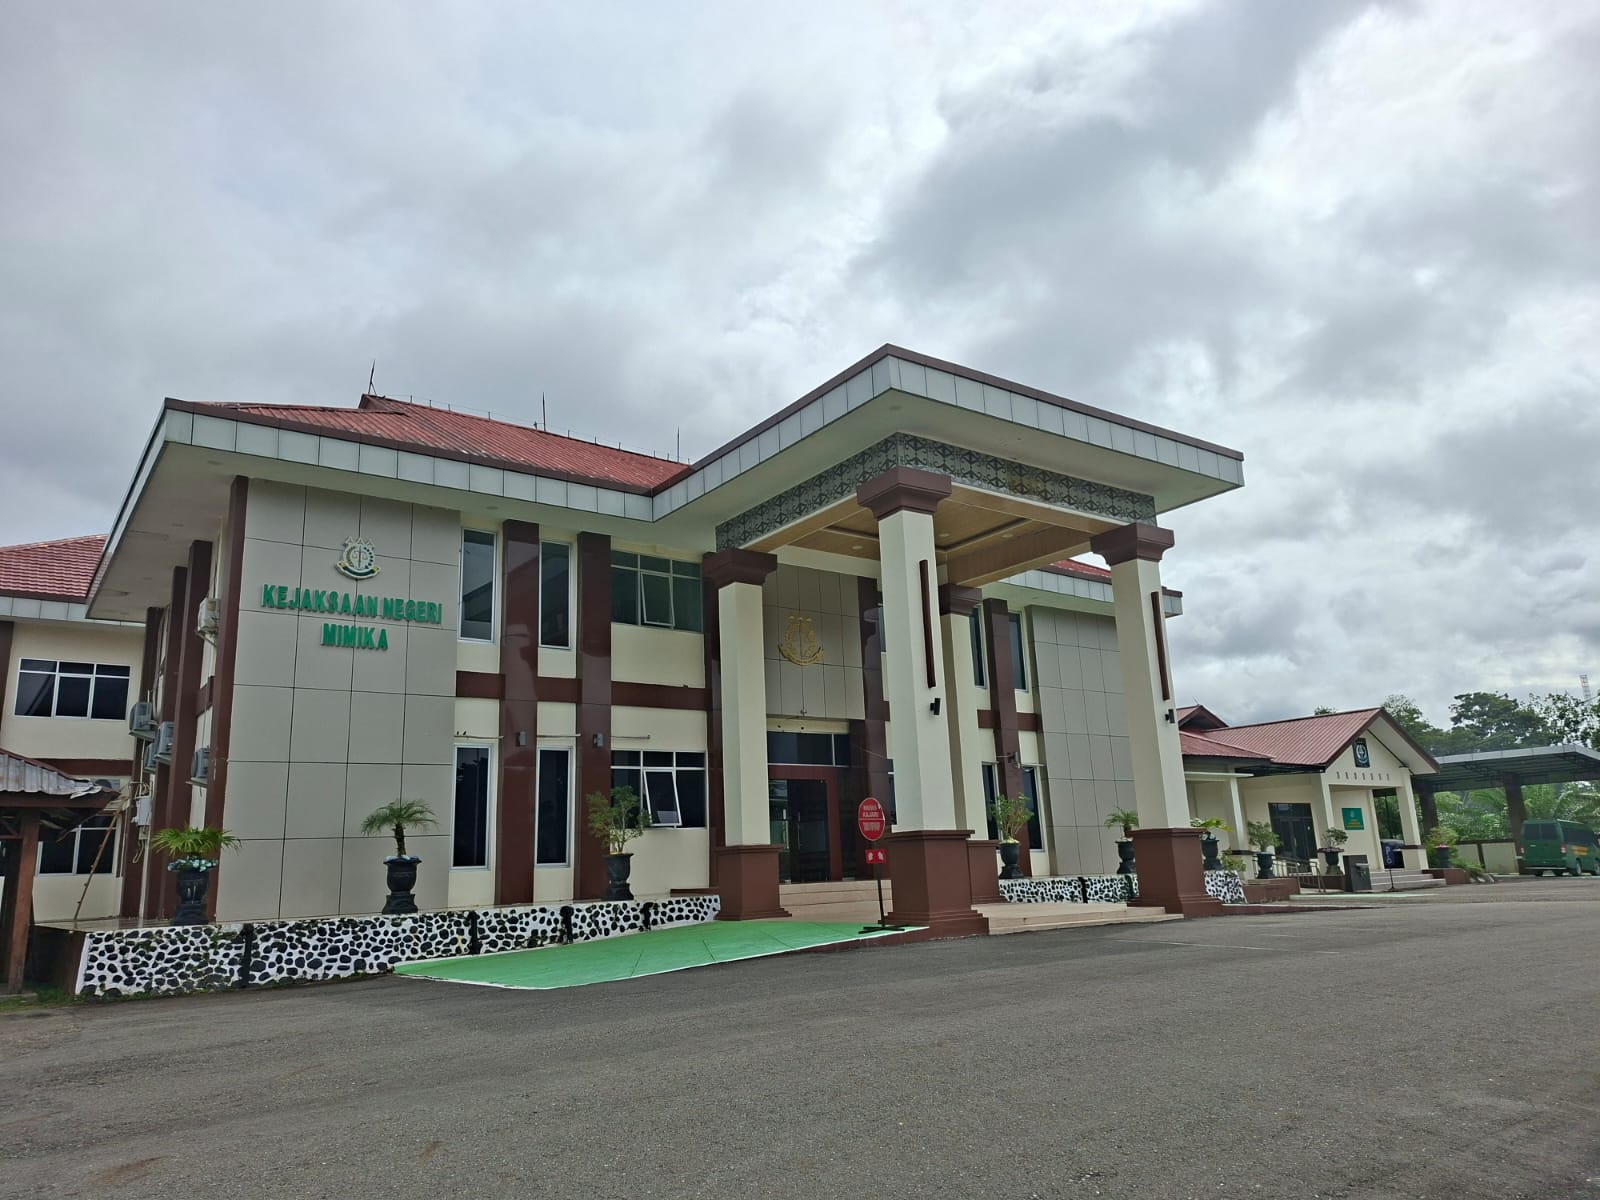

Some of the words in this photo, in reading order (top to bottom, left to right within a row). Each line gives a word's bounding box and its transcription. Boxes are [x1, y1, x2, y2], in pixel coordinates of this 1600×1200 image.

[262, 584, 378, 618] KEJAKSAAN
[381, 597, 442, 625] NEGERI
[321, 623, 388, 651] MIMIKA
